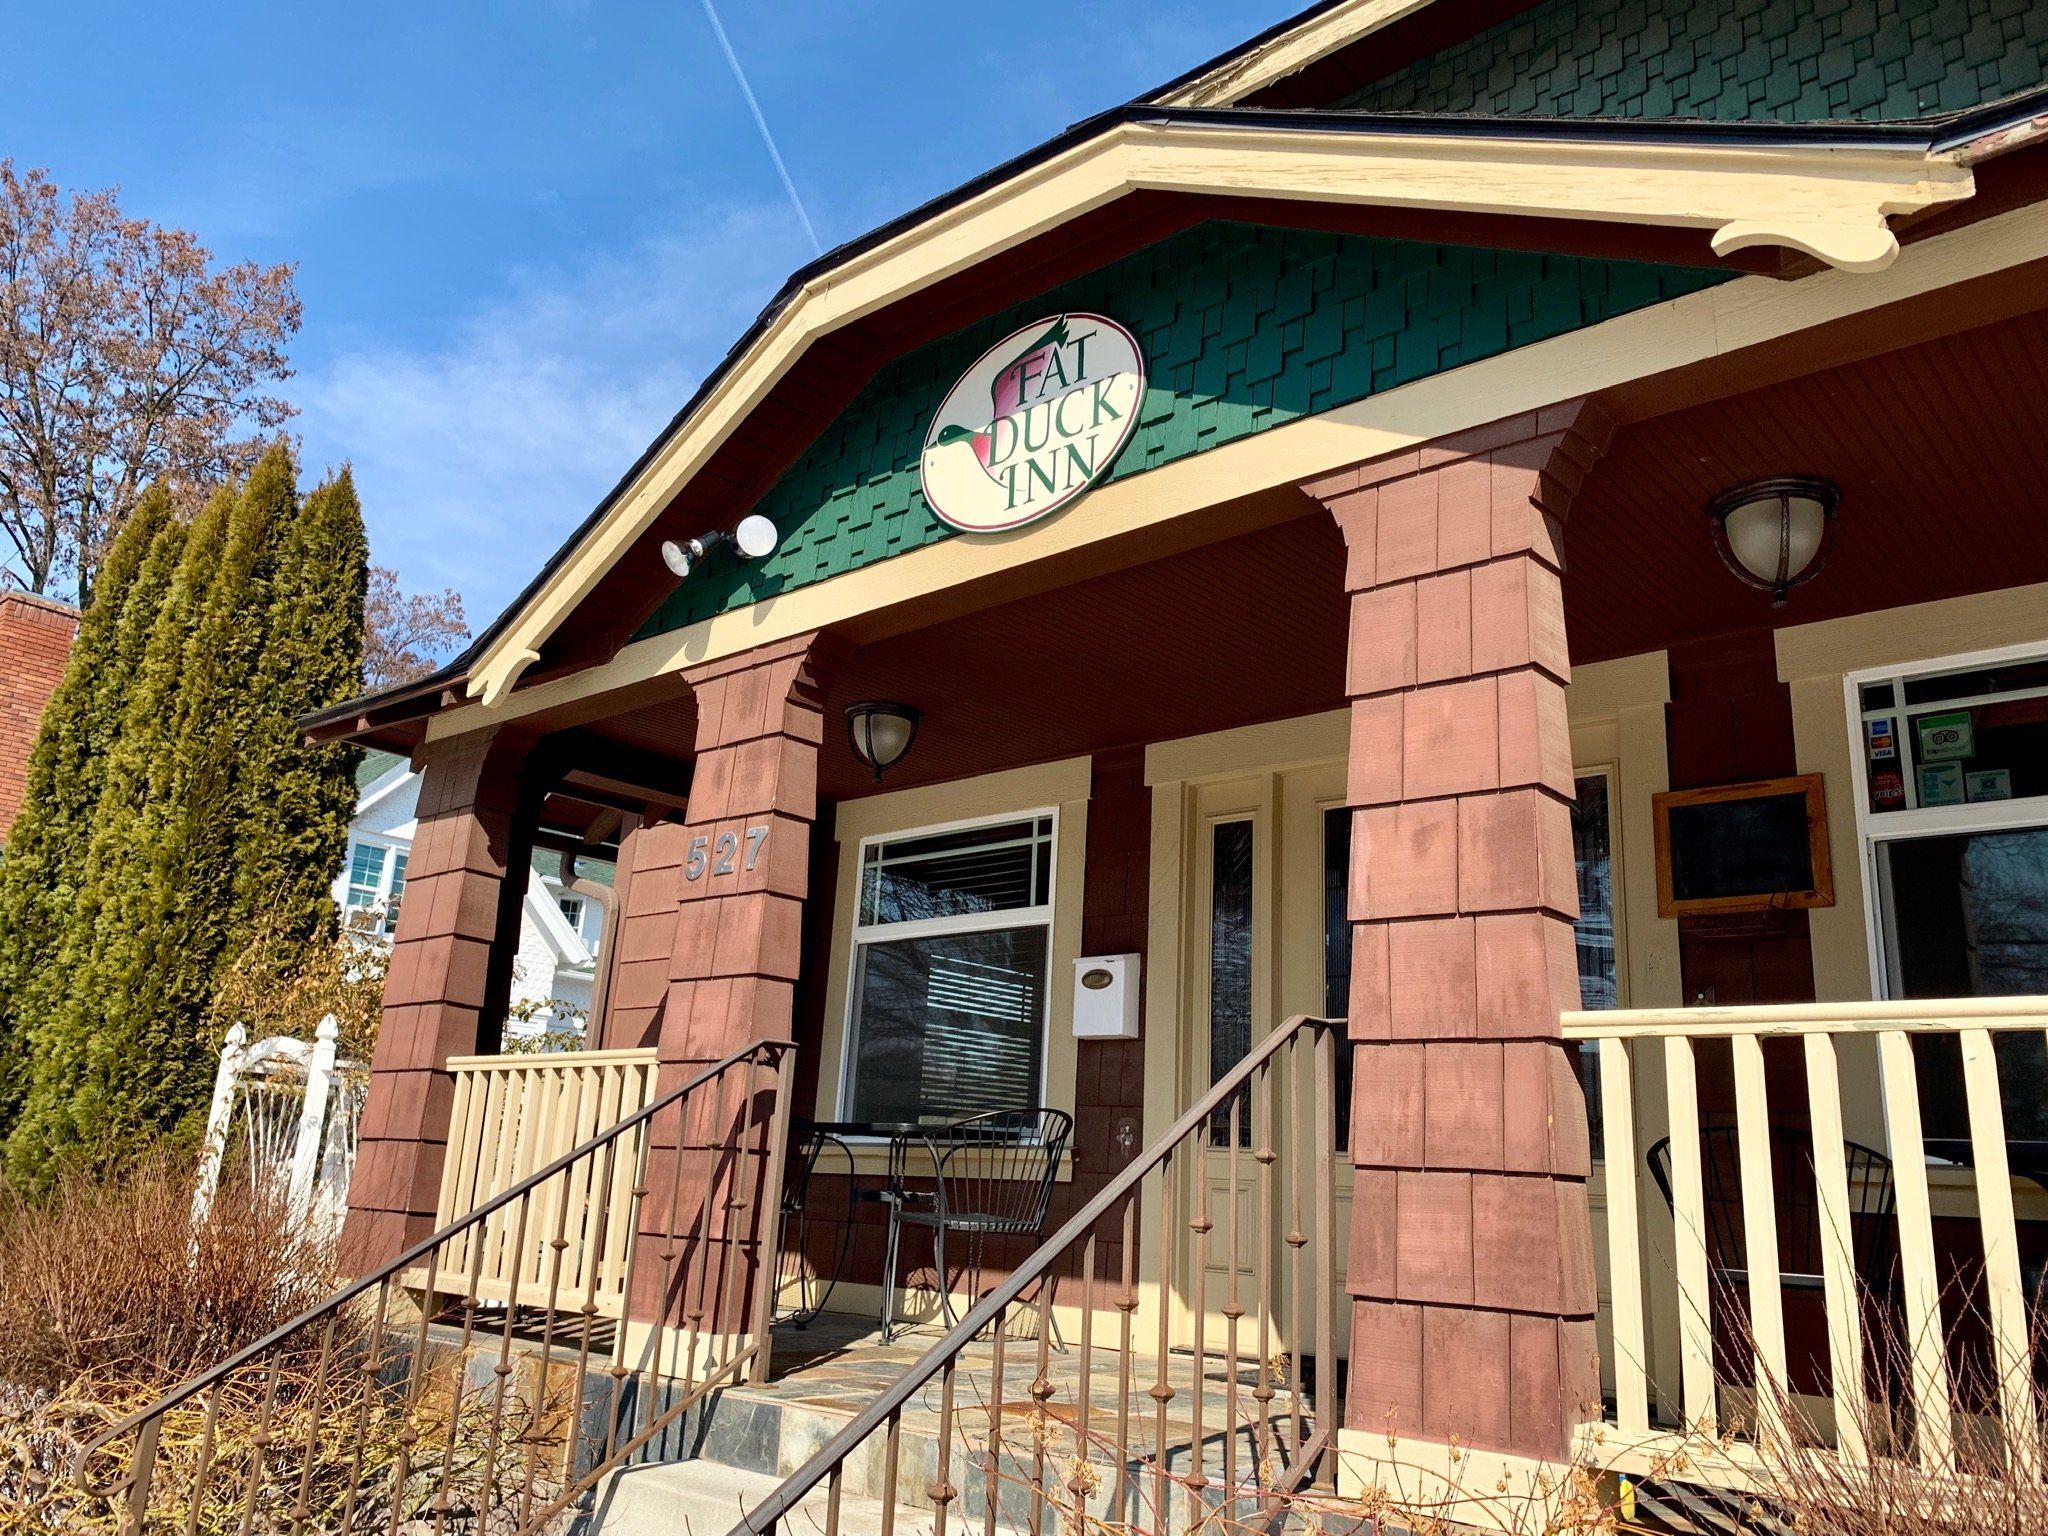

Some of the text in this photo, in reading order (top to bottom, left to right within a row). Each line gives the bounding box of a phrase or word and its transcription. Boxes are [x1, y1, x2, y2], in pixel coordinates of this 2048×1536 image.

[1009, 329, 1098, 408] FAT
[983, 371, 1123, 469] DUCK
[999, 433, 1100, 512] INN
[1874, 749, 1892, 757] VISA
[1926, 746, 1963, 756] tripadv
[1873, 789, 1895, 801] yelp
[684, 825, 769, 882] 527
